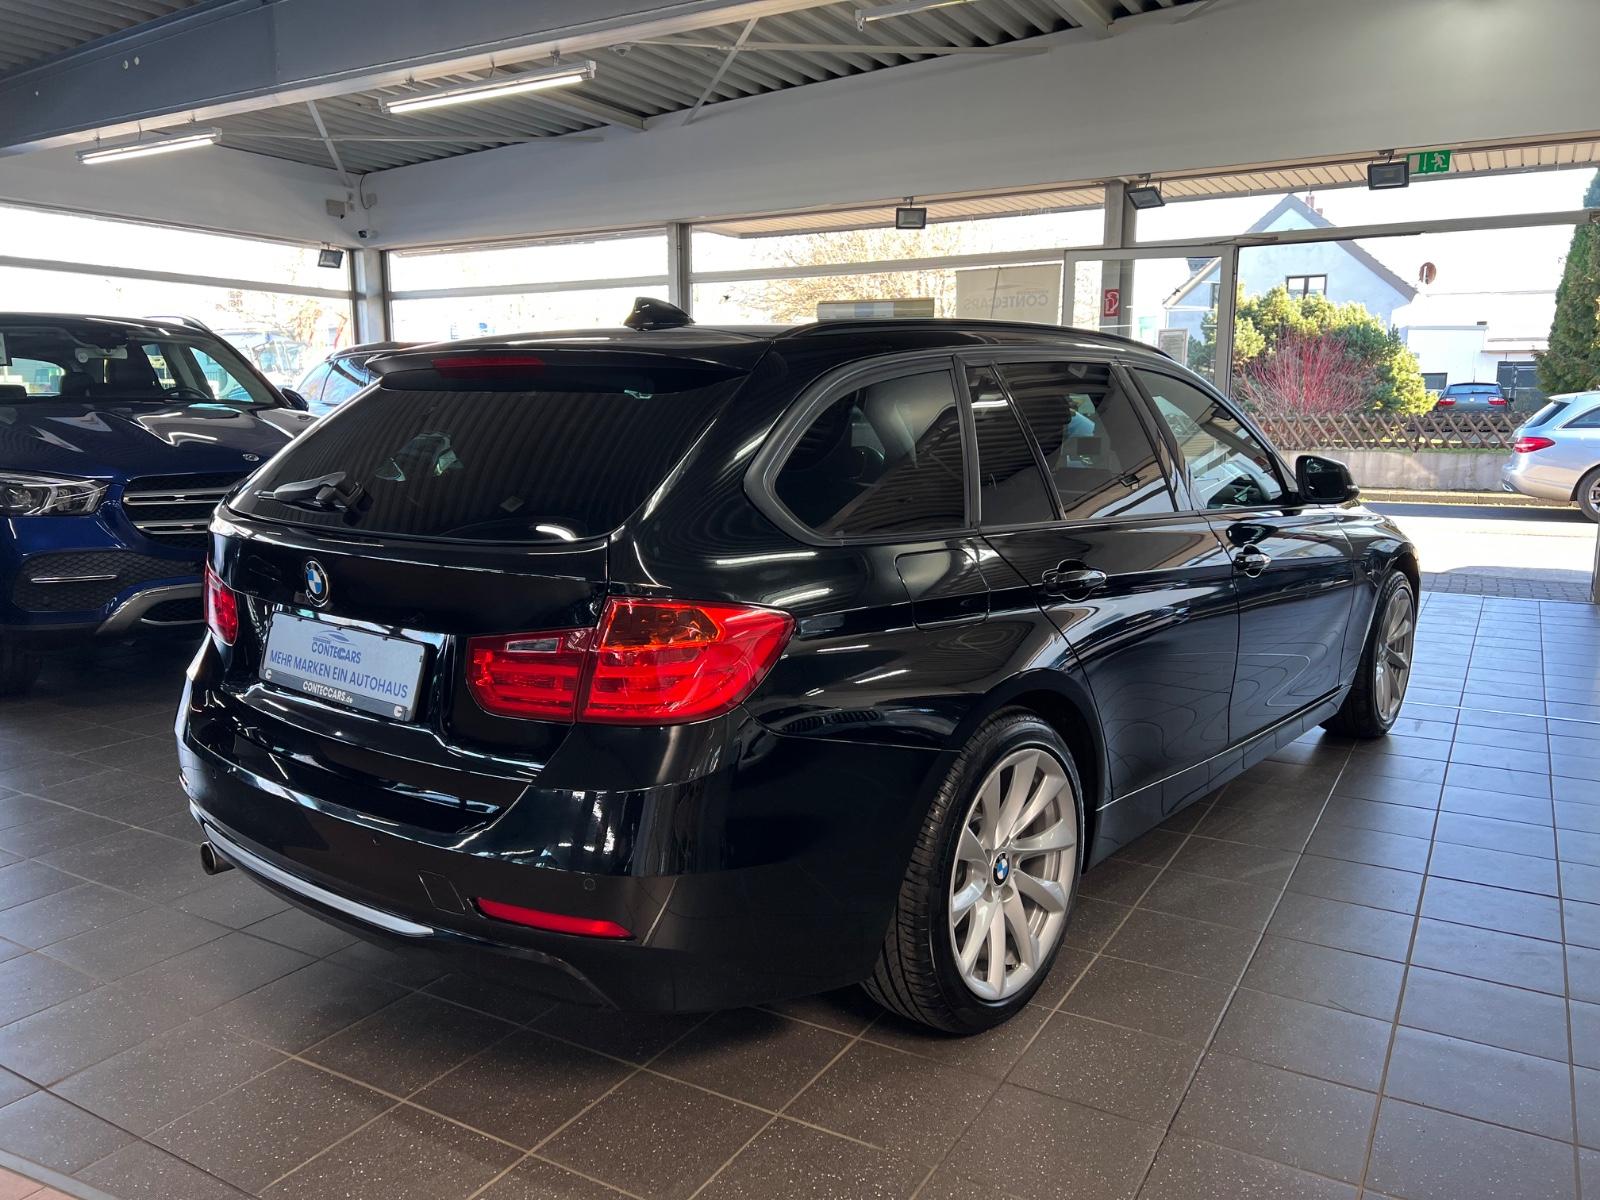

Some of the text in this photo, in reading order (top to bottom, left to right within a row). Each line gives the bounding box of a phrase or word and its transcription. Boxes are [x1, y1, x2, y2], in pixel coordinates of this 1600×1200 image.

[269, 650, 408, 699] MEHR MARKEN EIN AUTOHAUS
